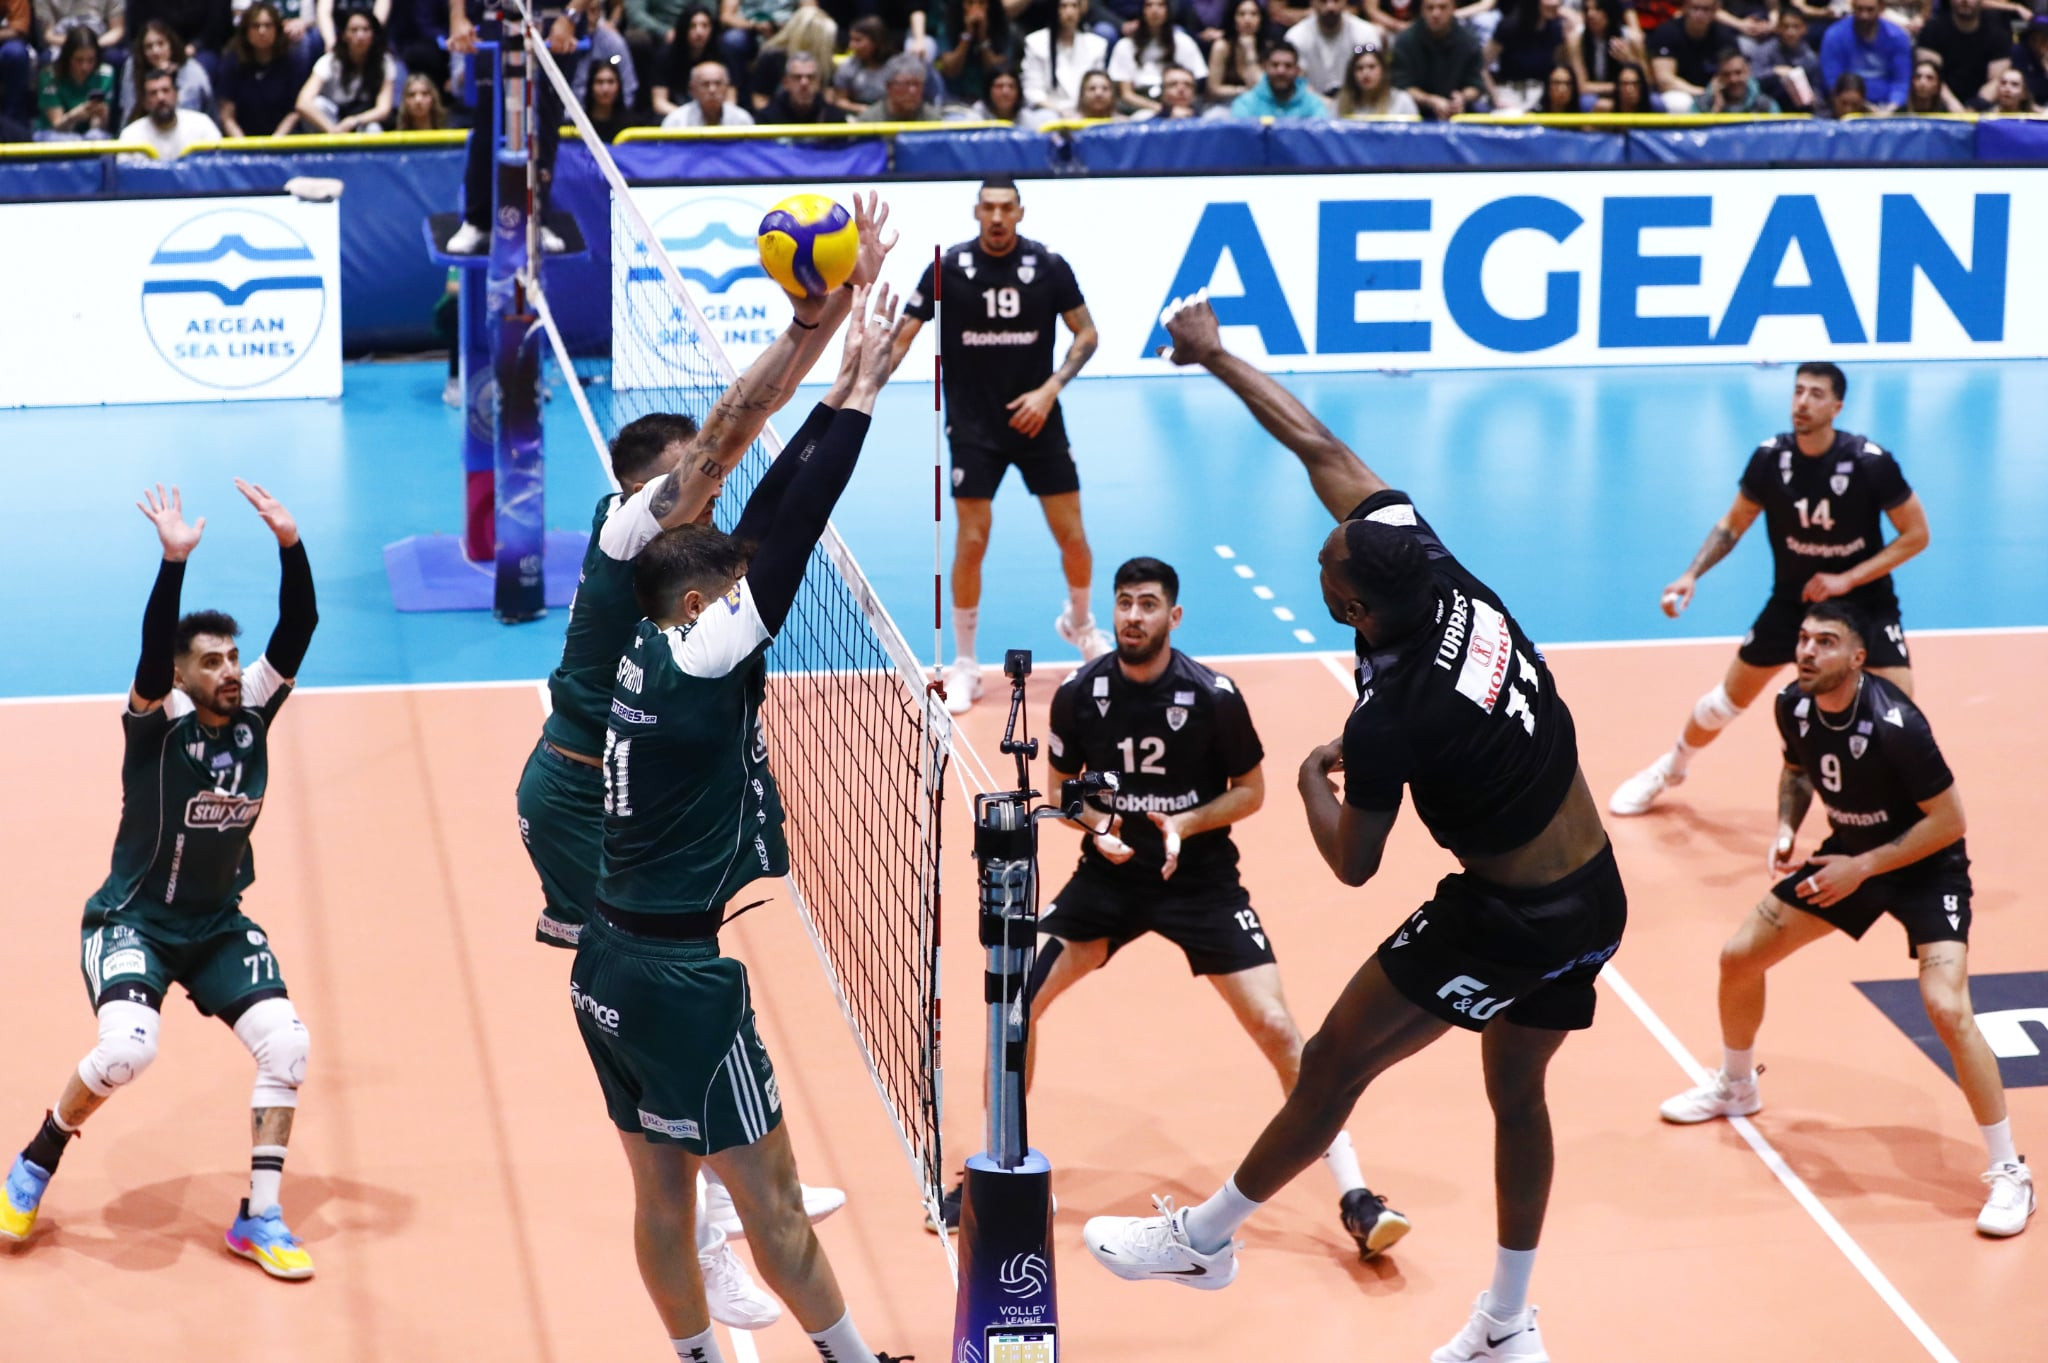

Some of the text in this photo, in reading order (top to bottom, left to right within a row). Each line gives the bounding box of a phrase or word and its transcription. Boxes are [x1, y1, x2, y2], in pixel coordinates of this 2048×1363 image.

[1140, 193, 2010, 358] AEGEAN
[669, 304, 767, 321] AGEAN
[982, 287, 1020, 318] 19
[186, 318, 285, 334] AEGEAN
[723, 328, 777, 345] INES
[174, 341, 295, 358] SEA LINES
[1794, 498, 1835, 530] 14
[1484, 615, 1510, 711] MORRIS
[1117, 736, 1166, 775] 12
[1820, 753, 1842, 793] 9
[1234, 909, 1260, 931] 12
[243, 952, 274, 985] 77
[999, 1305, 1047, 1316] VOLLEY
[1005, 1315, 1043, 1325] LEAGUE
